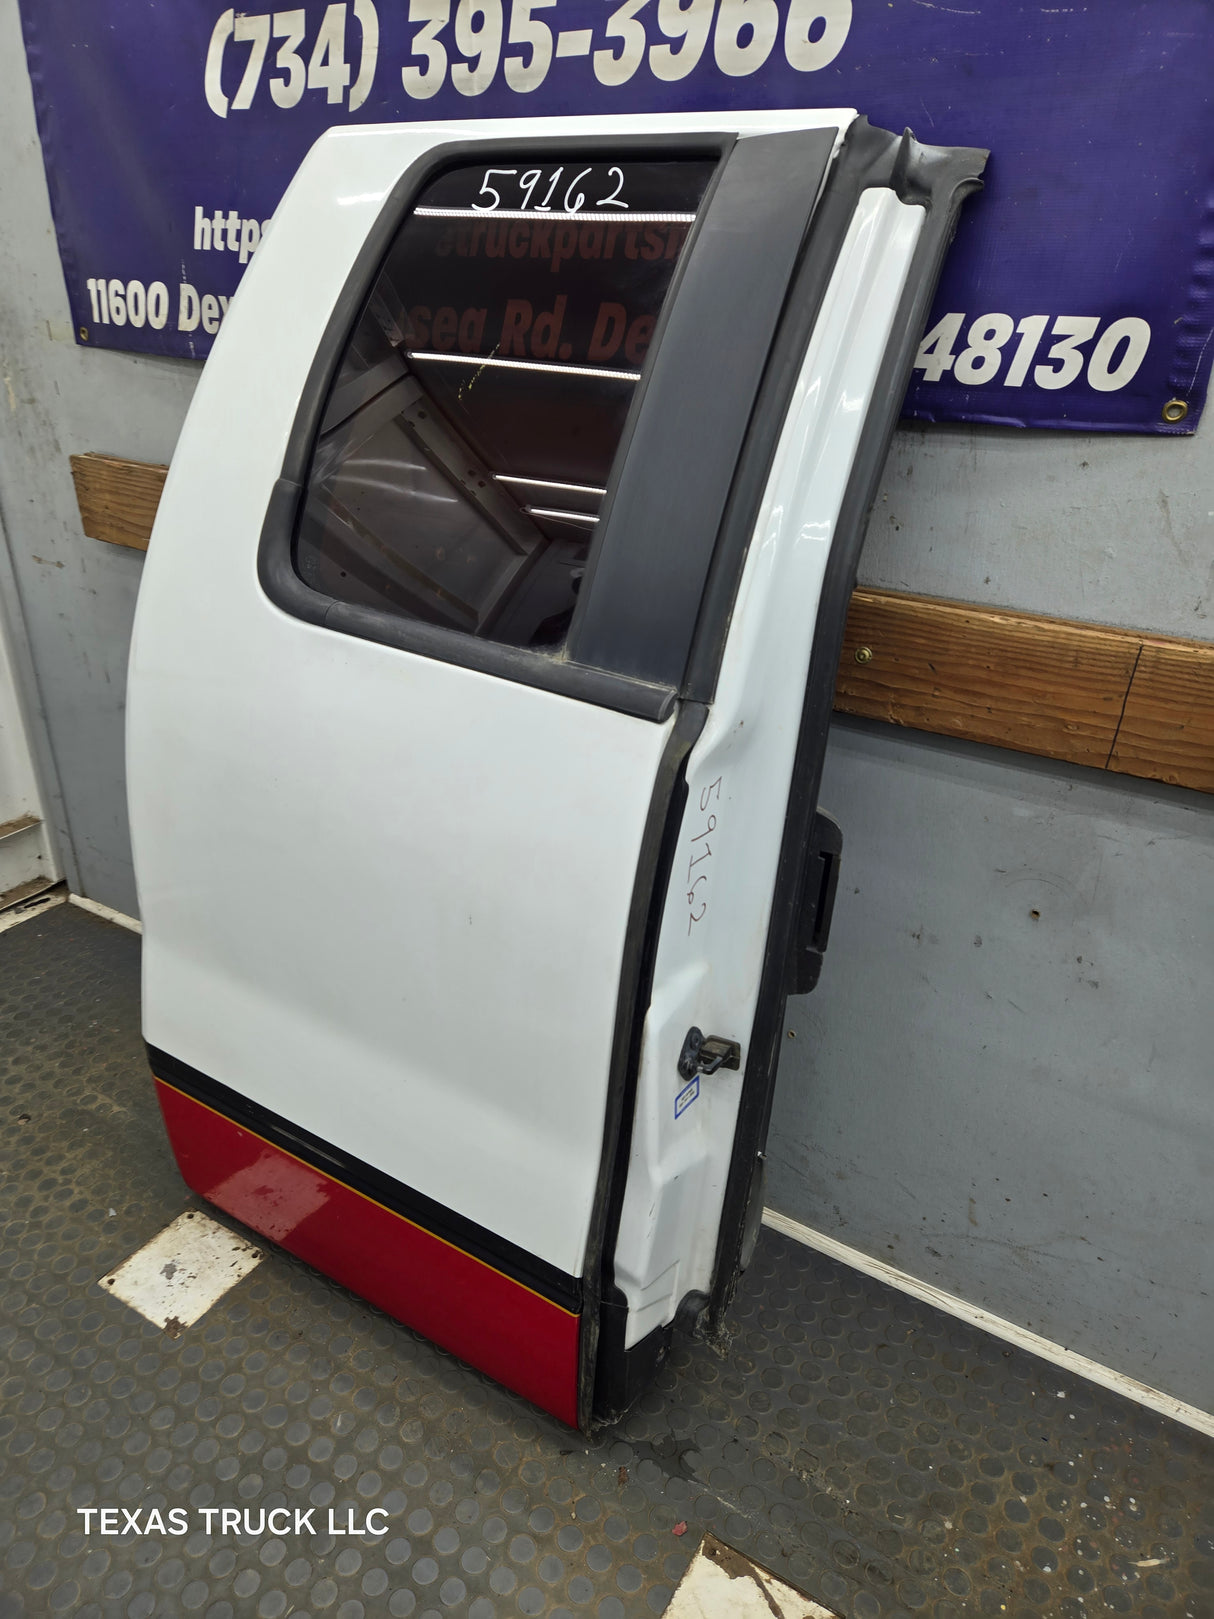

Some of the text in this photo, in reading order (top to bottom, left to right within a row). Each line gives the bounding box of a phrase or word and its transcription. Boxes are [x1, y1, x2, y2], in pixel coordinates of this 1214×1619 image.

[204, 0, 854, 119] (734) 395-3966
[471, 166, 629, 214] 59162
[86, 278, 170, 330] 11600
[499, 294, 573, 360] Rd.
[913, 312, 1152, 392] 48130
[687, 776, 723, 937] 59162
